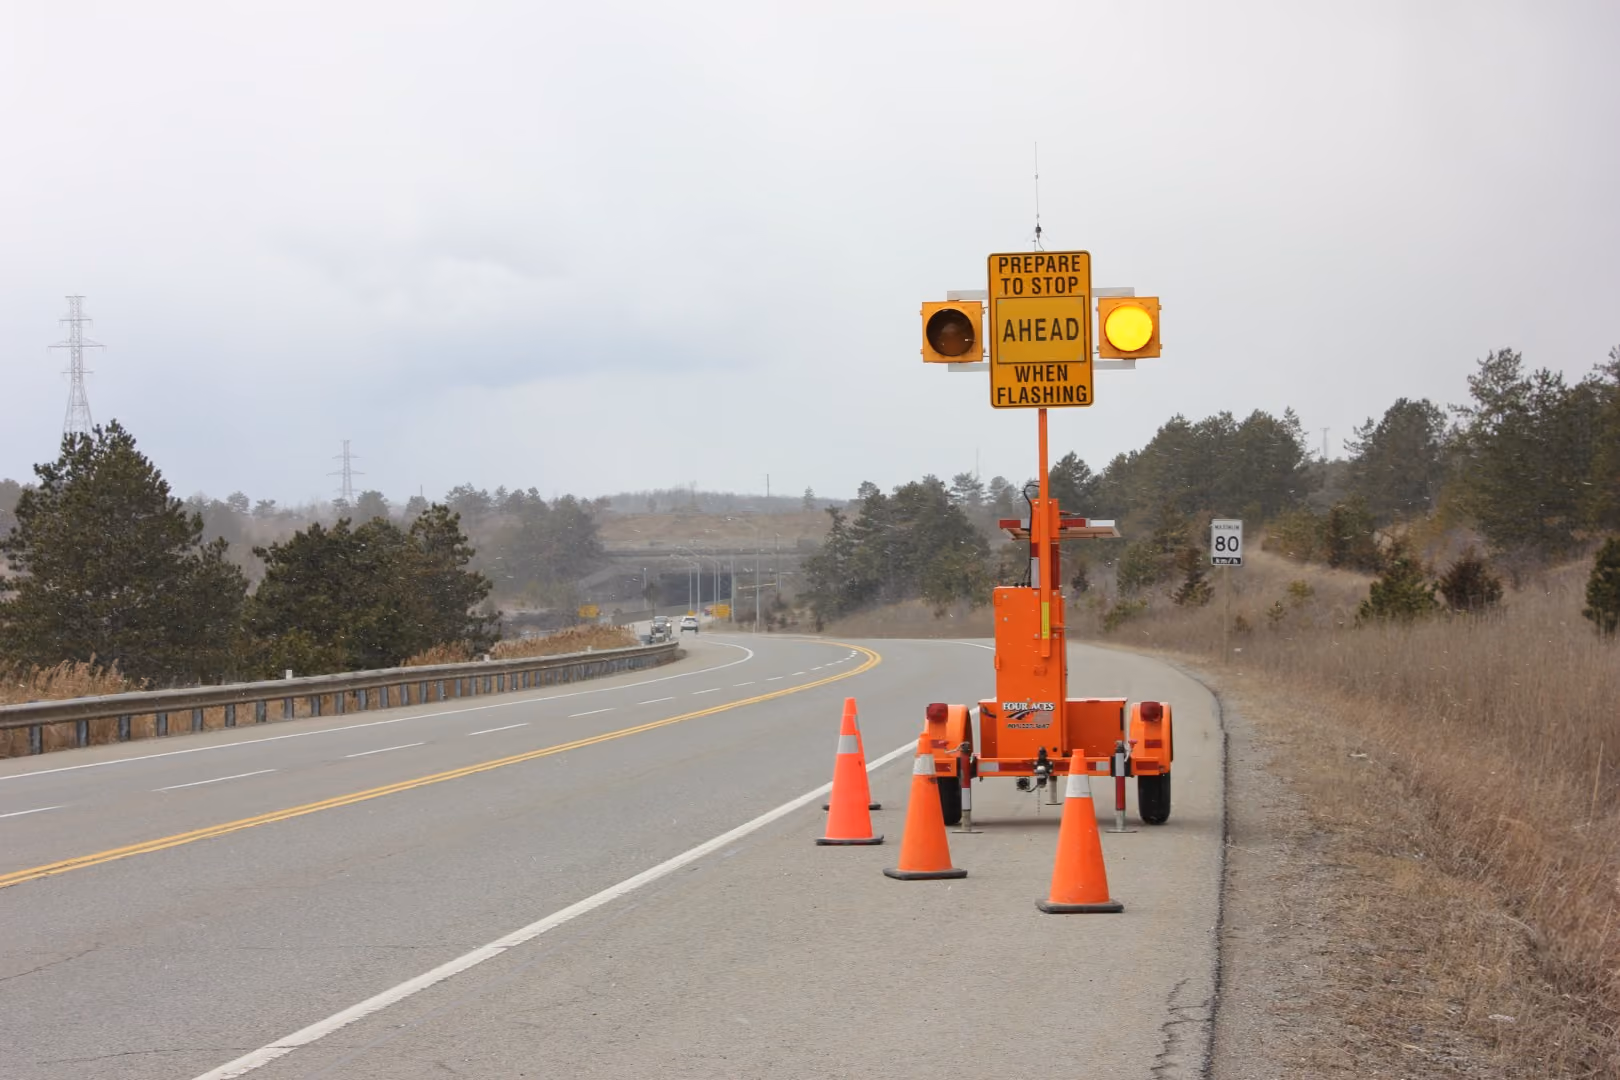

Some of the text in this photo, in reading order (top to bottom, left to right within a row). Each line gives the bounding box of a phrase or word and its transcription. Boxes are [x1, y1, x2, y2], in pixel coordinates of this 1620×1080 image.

[999, 255, 1080, 274] PREPARE
[1001, 276, 1078, 295] TO STOP
[1003, 317, 1079, 342] AHEAD
[1014, 364, 1068, 382] WHEN
[997, 384, 1087, 404] FLASHING
[1215, 535, 1239, 552] 80
[1003, 702, 1055, 711] FOUR ACES
